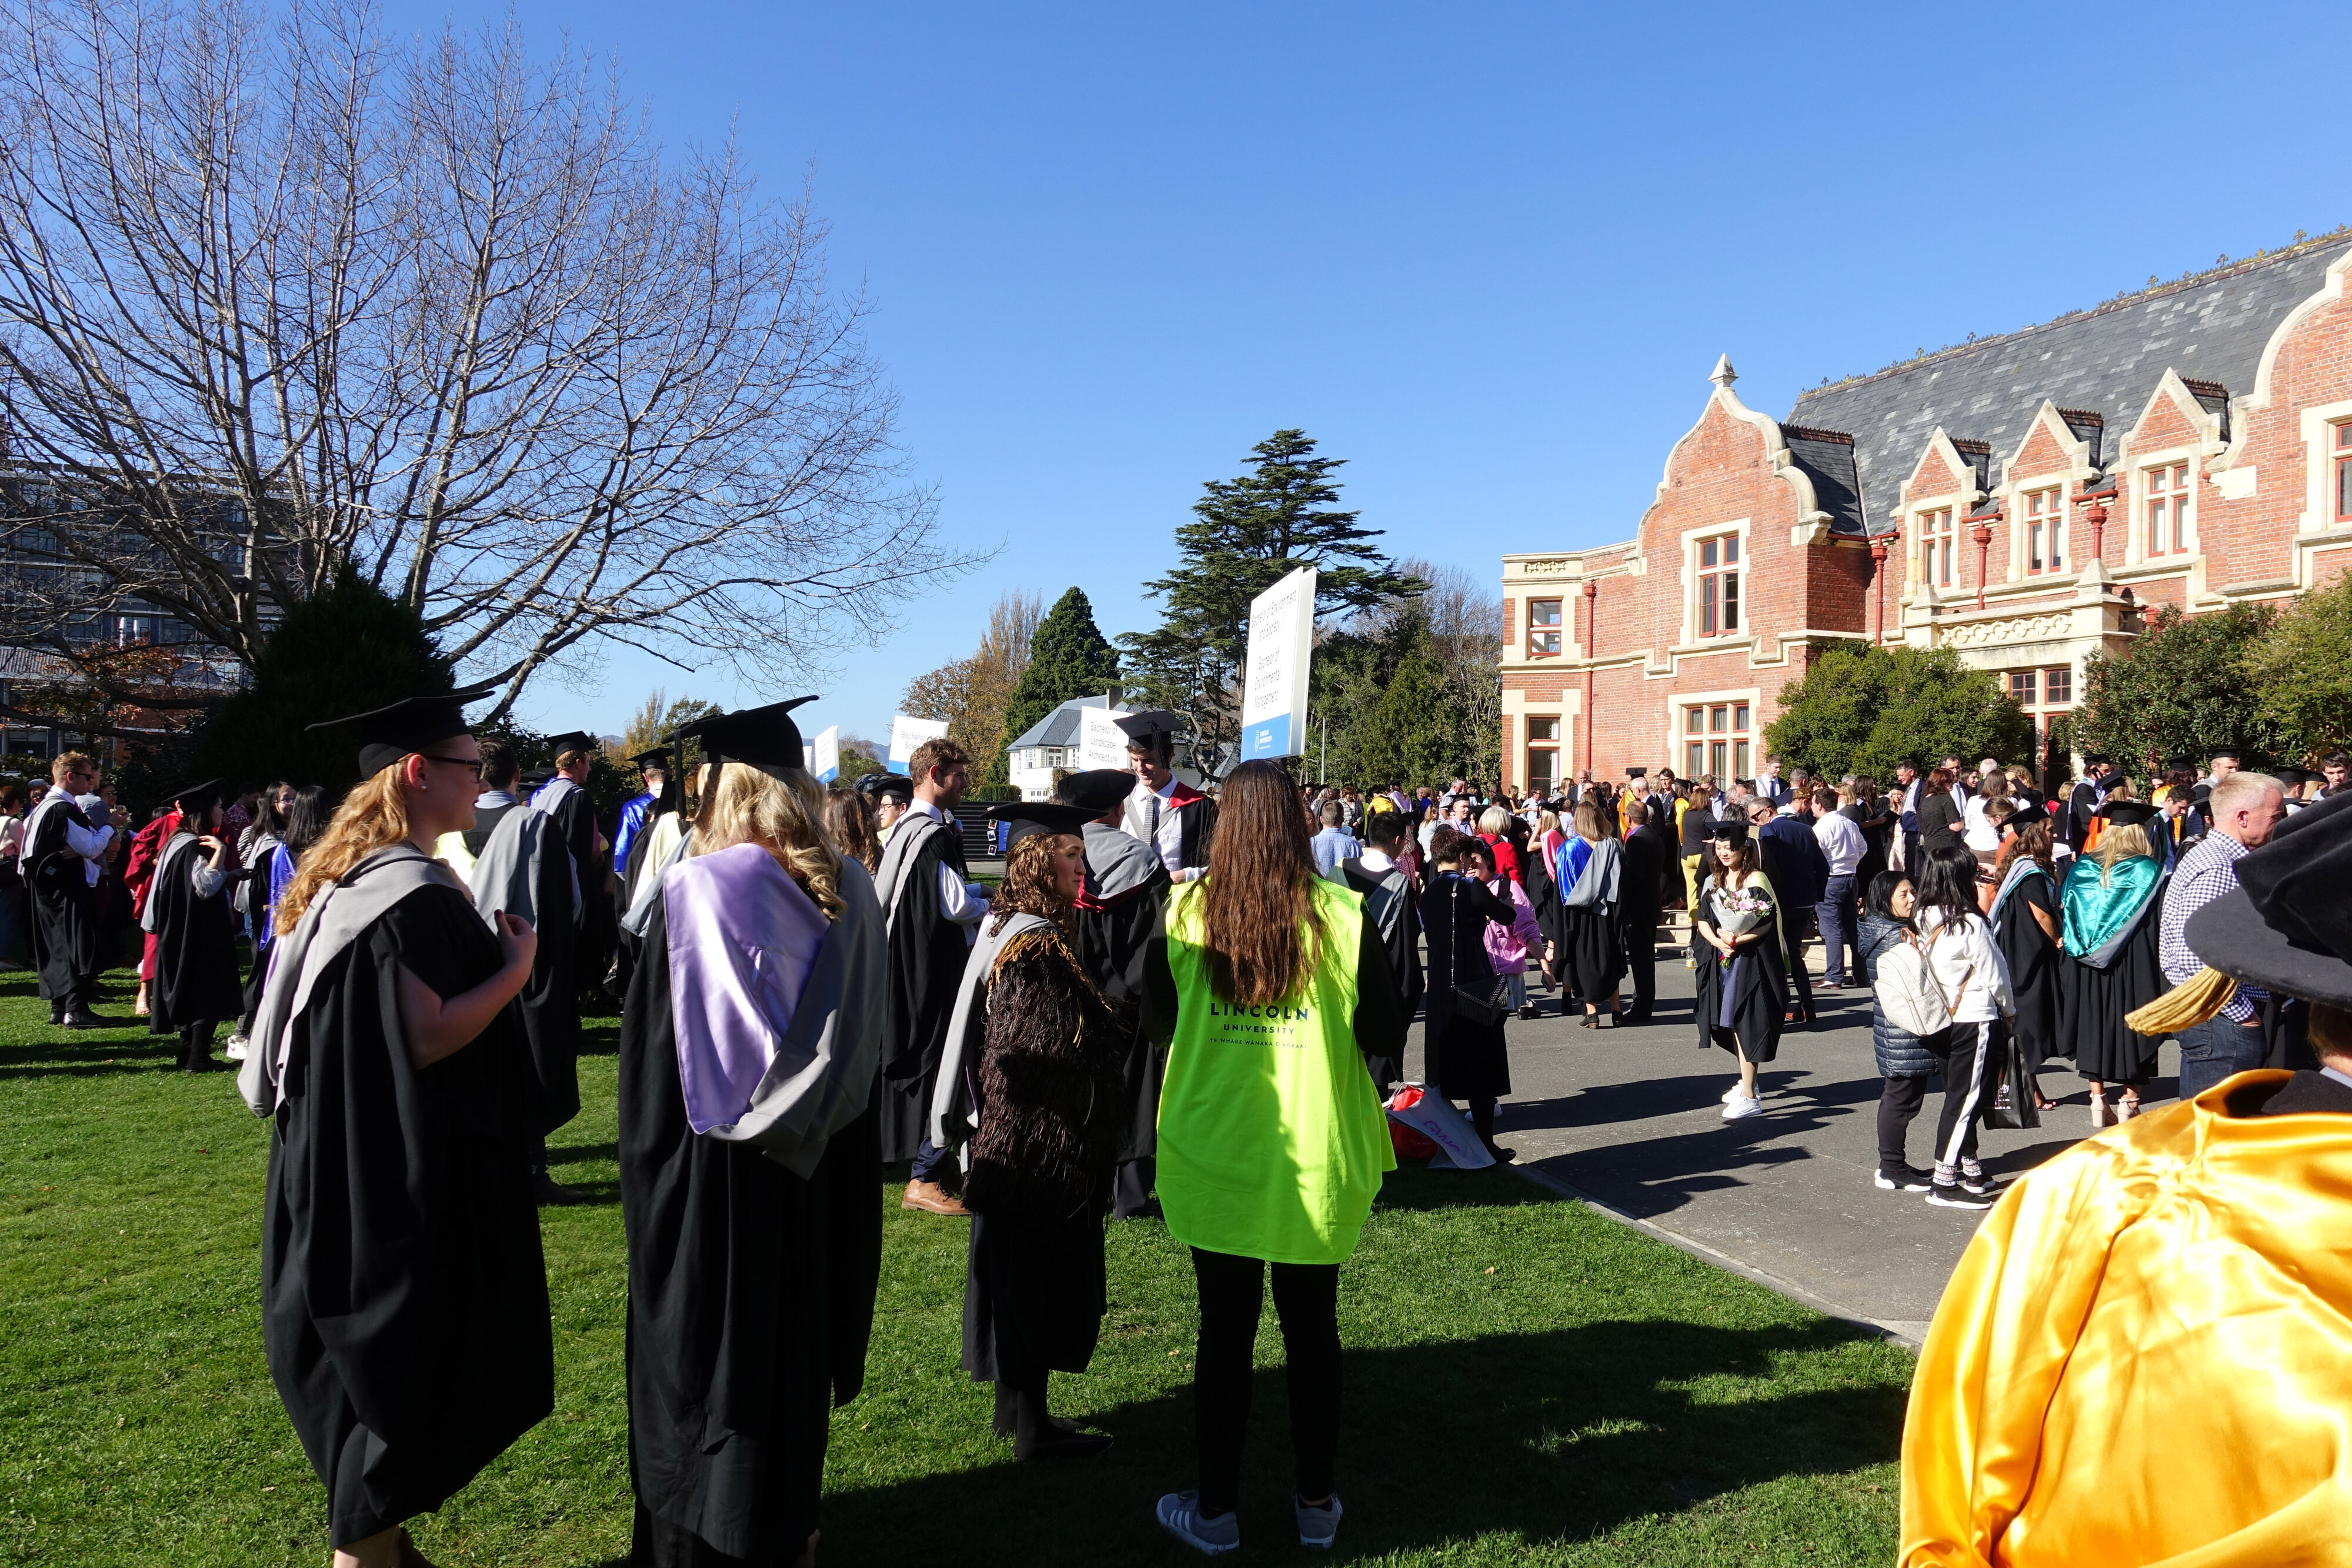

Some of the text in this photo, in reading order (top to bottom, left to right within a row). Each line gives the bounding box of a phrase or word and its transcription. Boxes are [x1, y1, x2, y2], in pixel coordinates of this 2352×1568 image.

[1271, 589, 1297, 615] Environment
[1259, 650, 1275, 670] Bachelor
[902, 730, 926, 741] Bachelor
[1091, 722, 1117, 735] Bachelor of
[1091, 736, 1116, 750] Landscape
[1089, 749, 1117, 764] Architecture
[1210, 1002, 1308, 1020] LINCOLN
[1223, 1024, 1294, 1035] UNIVERSITY
